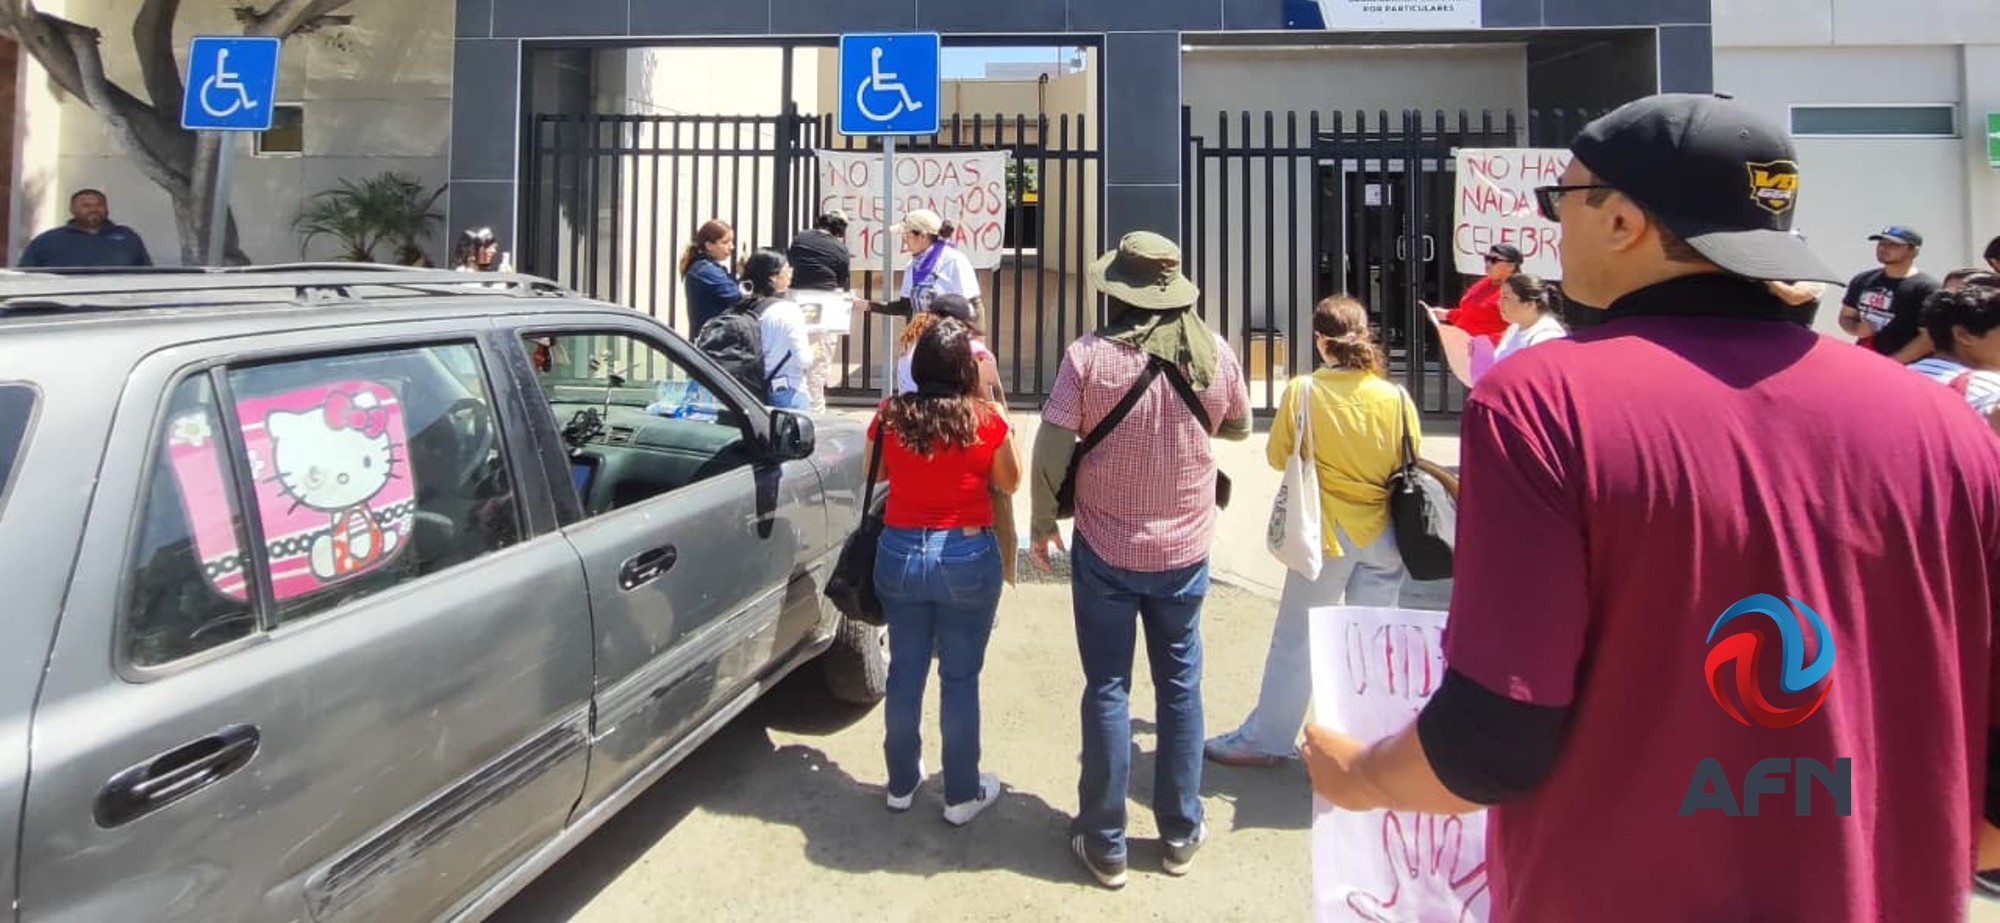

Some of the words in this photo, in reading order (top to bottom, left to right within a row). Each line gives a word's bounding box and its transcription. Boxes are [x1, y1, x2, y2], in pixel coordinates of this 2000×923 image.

[827, 160, 868, 188] NO
[1467, 153, 1510, 180] NO
[1462, 185, 1531, 217] NADA
